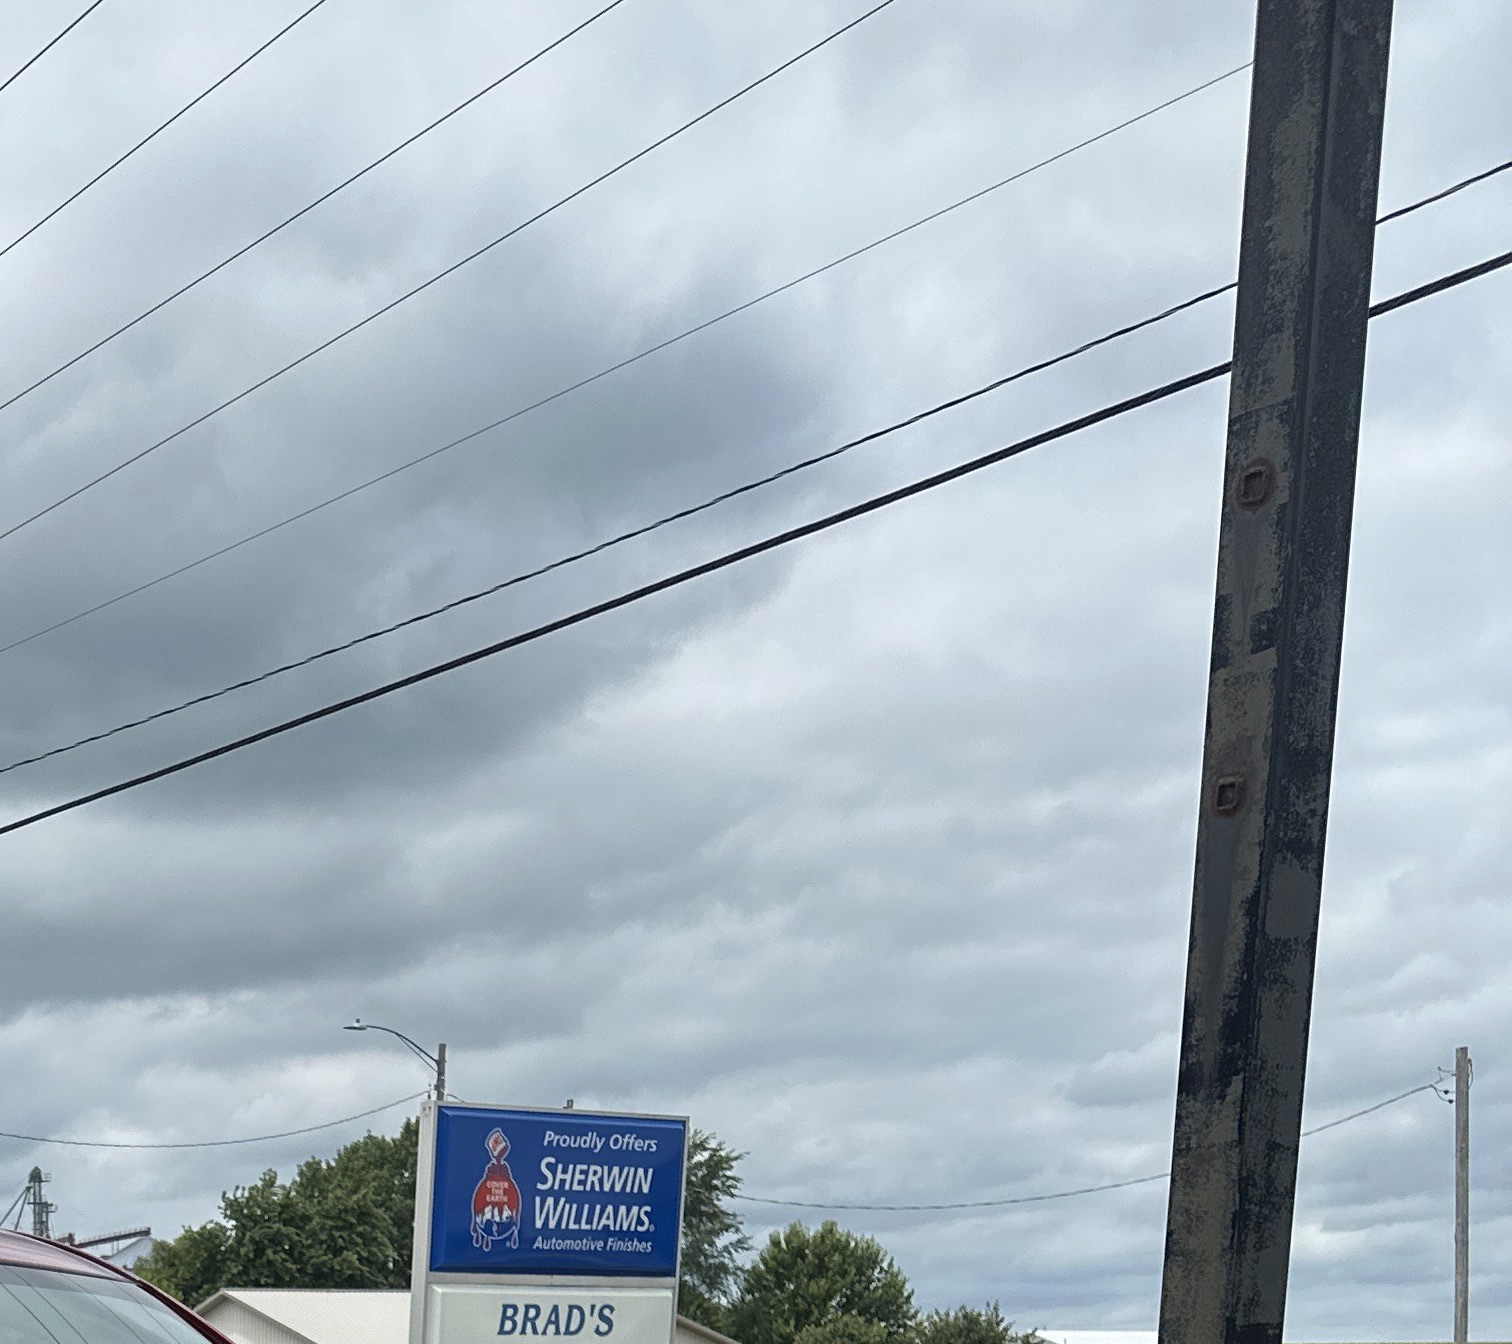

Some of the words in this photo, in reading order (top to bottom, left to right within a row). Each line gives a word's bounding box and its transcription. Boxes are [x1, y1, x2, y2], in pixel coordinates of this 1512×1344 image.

[543, 1131, 605, 1153] Proudly
[609, 1133, 658, 1152] Offers
[536, 1156, 654, 1194] SHERWIN
[534, 1195, 652, 1232] WILLIAMS
[532, 1236, 605, 1251] Automotive
[606, 1237, 653, 1253] Finishes
[497, 1303, 616, 1337] BRAD'S
